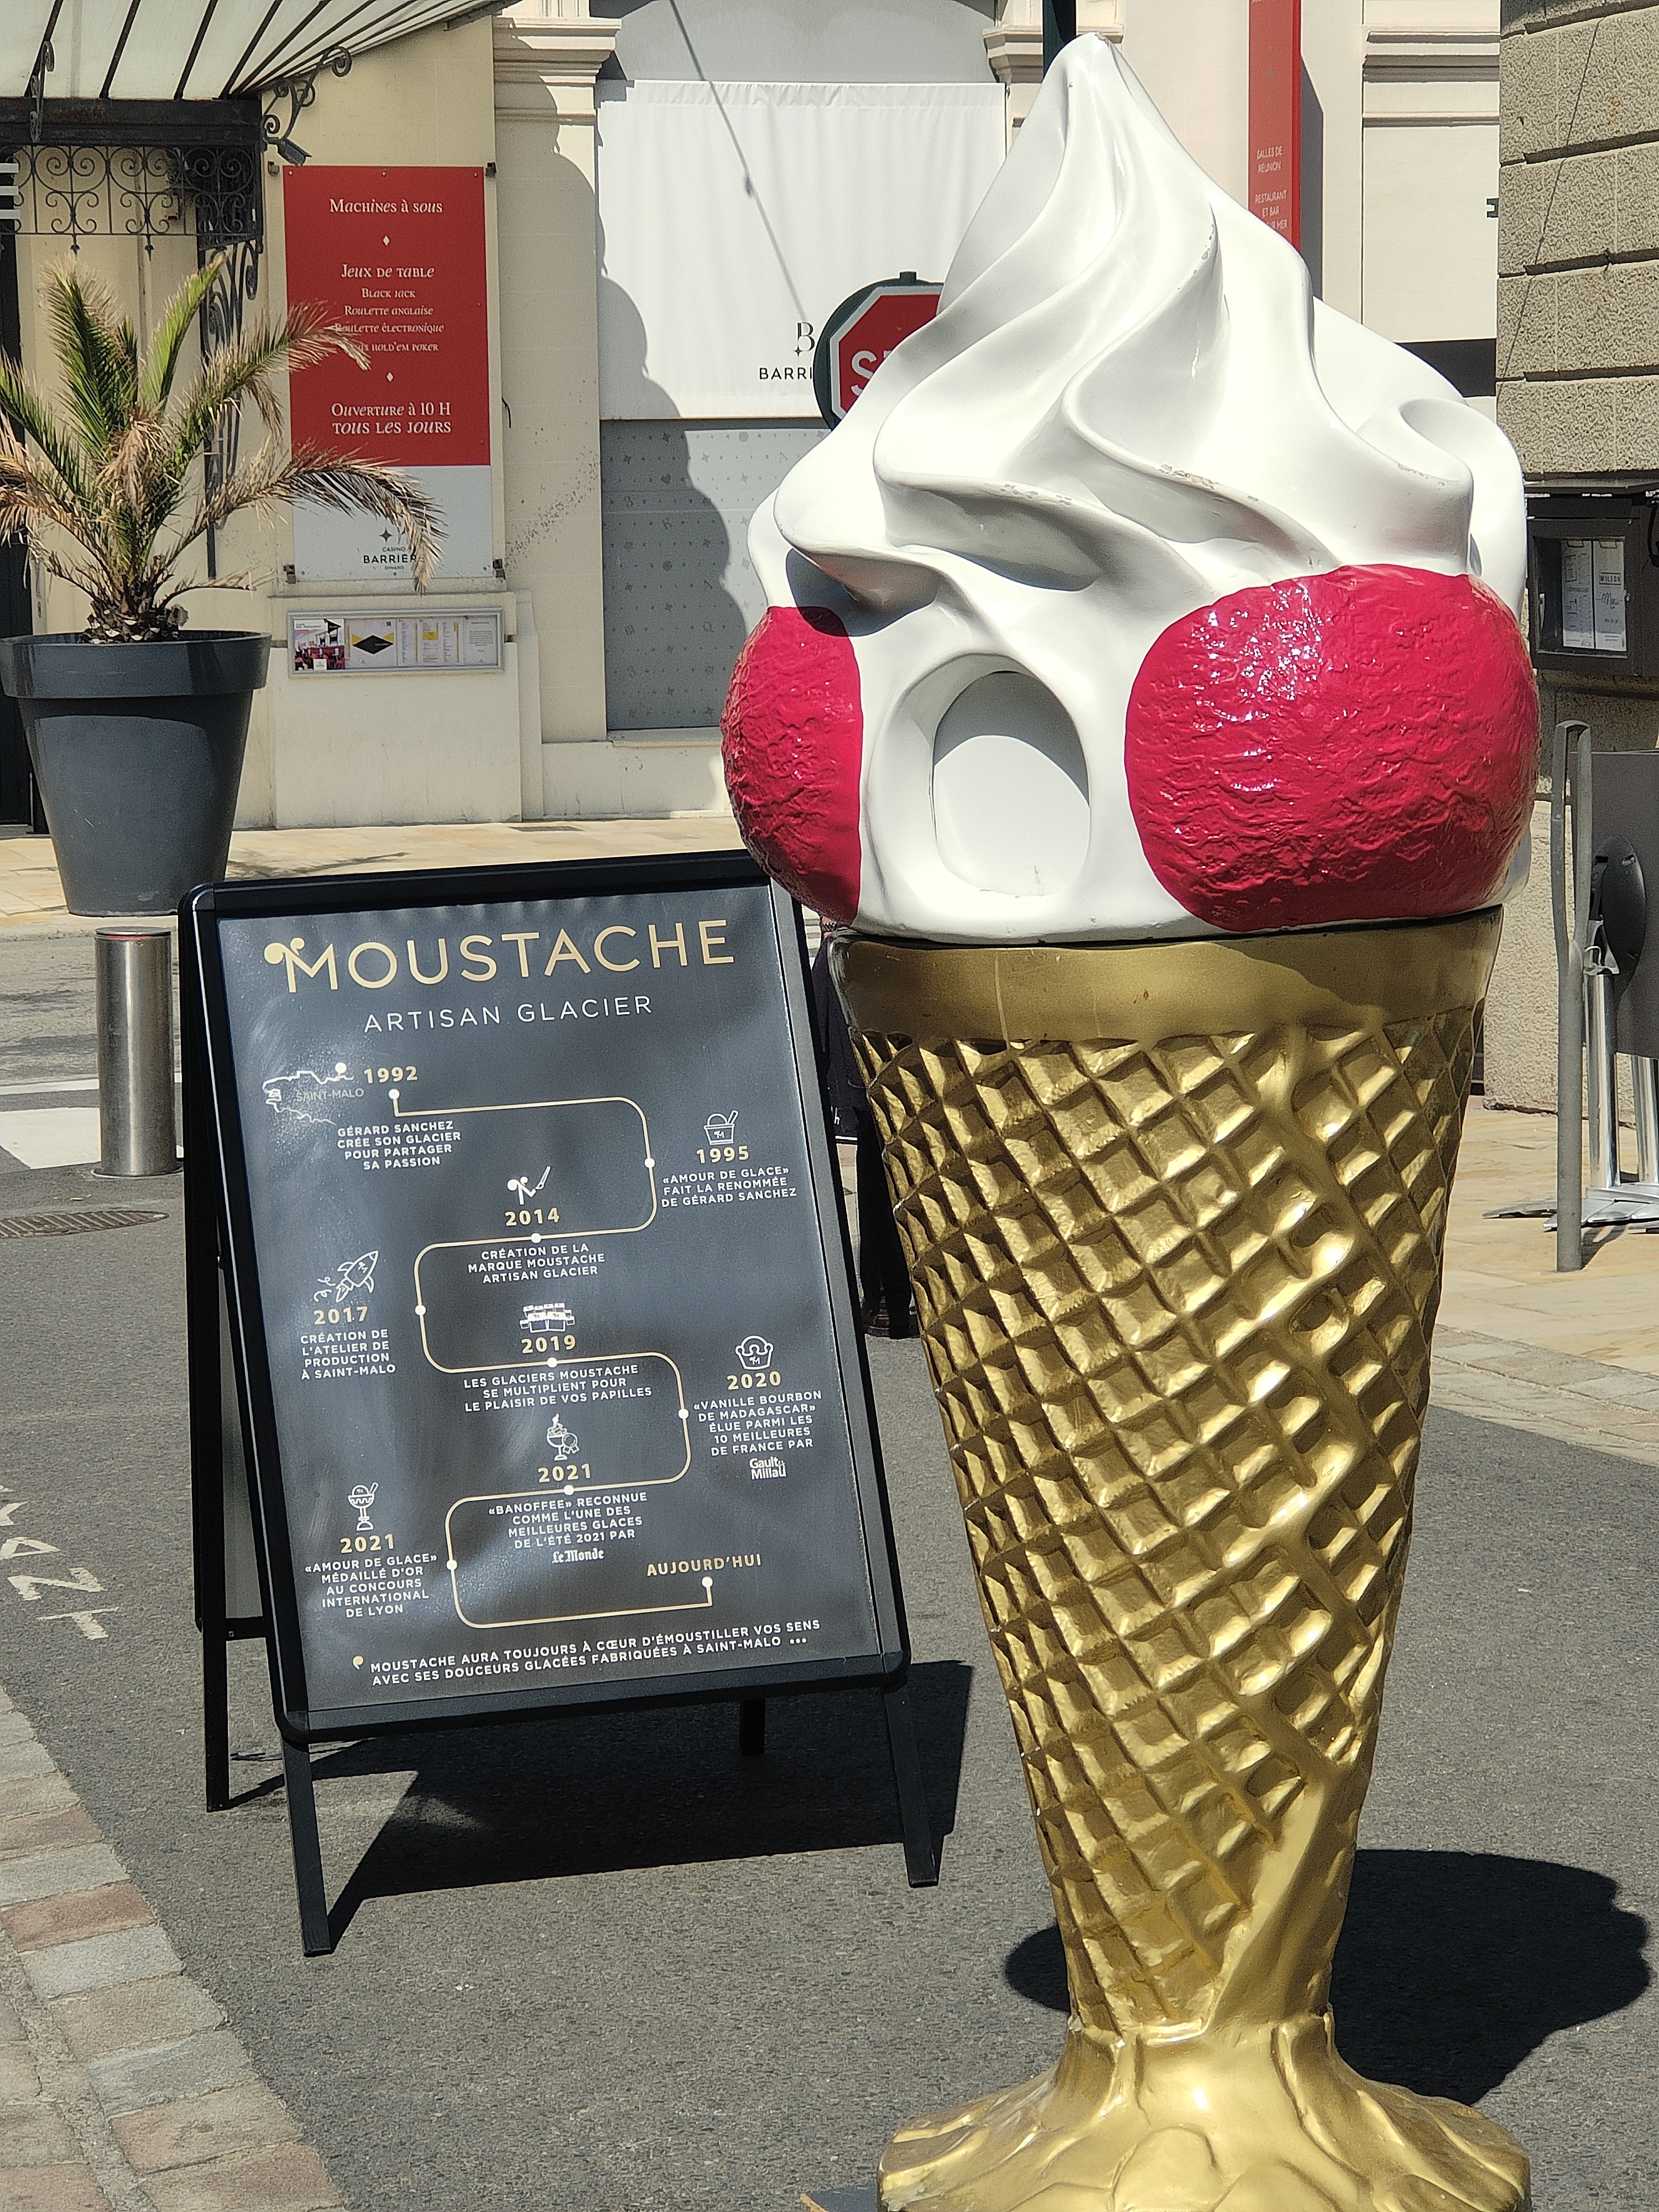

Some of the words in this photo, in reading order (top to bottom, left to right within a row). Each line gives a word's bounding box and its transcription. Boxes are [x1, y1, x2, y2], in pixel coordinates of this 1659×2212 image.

[330, 199, 397, 213] Machines
[401, 199, 409, 213] à
[413, 203, 442, 213] sous
[341, 264, 372, 278] Jeux
[362, 288, 392, 298] Black
[345, 305, 389, 316] Roulette
[391, 305, 434, 315] anglaise
[331, 403, 404, 416] Ouverture
[408, 402, 416, 416] à
[421, 402, 434, 415] 10
[439, 402, 450, 415] H
[264, 920, 734, 993] MOUSTACHE
[364, 1006, 500, 1033] ARTISAN
[518, 995, 651, 1022] GLACIER
[364, 1066, 418, 1083] 1992
[337, 1125, 389, 1137] GÉRARD
[394, 1120, 453, 1133] SANCHEZ
[337, 1136, 370, 1149] CRÉE
[374, 1136, 401, 1146] SON
[406, 1131, 461, 1144] GLACIER
[345, 1149, 379, 1160] POUR
[384, 1144, 452, 1157] PARTAGER
[696, 1145, 749, 1164] 1995
[363, 1160, 380, 1170] SA
[384, 1156, 440, 1168] PASSION
[662, 1172, 715, 1184] «AMOUR
[719, 1170, 736, 1180] DE
[741, 1166, 789, 1177] GLACE»
[664, 1185, 692, 1196] FAIT
[697, 1183, 713, 1193] LA
[717, 1176, 787, 1191] RENOMMÉE
[661, 1198, 678, 1207] DE
[682, 1193, 733, 1206] GÉRARD
[738, 1187, 797, 1201] SANCHEZ
[505, 1208, 560, 1226] 2014
[481, 1246, 546, 1260] CRÉATION
[551, 1245, 568, 1255] DE
[572, 1243, 589, 1253] LA
[468, 1260, 522, 1273] MARQUE
[526, 1253, 605, 1268] MOUSTACHE
[483, 1270, 538, 1284] ARTISAN
[543, 1266, 598, 1278] GLACIER
[314, 1306, 368, 1325] 2017
[300, 1331, 366, 1344] CRÉATION
[371, 1329, 388, 1339] DE
[521, 1334, 576, 1354] 2019
[302, 1343, 368, 1356] L'ATELIER
[372, 1340, 389, 1350] DE
[305, 1352, 389, 1368] PRODUCTION
[301, 1369, 310, 1380] À
[315, 1364, 396, 1379] SAINT-MALO
[464, 1378, 487, 1389] LES
[492, 1372, 555, 1386] GLACIERS
[560, 1364, 638, 1380] MOUSTACHE
[727, 1371, 781, 1390] 2020
[483, 1389, 499, 1399] SE
[503, 1381, 586, 1397] MULTIPLIENT
[592, 1378, 626, 1389] POUR
[465, 1402, 480, 1412] LE
[485, 1397, 535, 1410] PLAISIR
[540, 1395, 556, 1405] DE
[561, 1392, 587, 1403] VOS
[592, 1387, 652, 1401] PAPILLES
[693, 1396, 755, 1410] «VANILLE
[759, 1390, 821, 1405] BOURBON
[698, 1412, 715, 1422] DE
[719, 1404, 816, 1420] MADAGASCAR»
[709, 1421, 741, 1433] ÉLUE
[745, 1417, 785, 1430] PARMI
[790, 1415, 812, 1425] LES
[714, 1434, 728, 1444] 10
[733, 1427, 811, 1442] MEILLEURES
[711, 1446, 728, 1456] DE
[732, 1441, 784, 1454] FRANCE
[788, 1438, 813, 1449] PAR
[538, 1463, 591, 1483] 2021
[751, 1467, 786, 1480] Millau
[488, 1499, 572, 1515] «BANOFFEE»
[577, 1492, 648, 1507] RECONNUE
[513, 1511, 559, 1525] COMME
[564, 1508, 602, 1520] L'UNE
[606, 1505, 631, 1516] DES
[508, 1521, 587, 1538] MEILLEURES
[592, 1516, 643, 1530] GLACES
[340, 1533, 394, 1553] 2021
[514, 1538, 531, 1549] DE
[536, 1533, 571, 1547] L'ÉTÉ
[576, 1531, 604, 1543] 2021
[609, 1529, 635, 1540] PAR
[305, 1560, 359, 1573] «AMOUR
[364, 1557, 382, 1568] DE
[387, 1553, 437, 1566] GLACE»
[647, 1553, 761, 1577] AUJOURD'HUI
[321, 1567, 387, 1584] MÉDAILLÉ
[392, 1566, 423, 1578] D'OR
[326, 1585, 344, 1595] AU
[349, 1578, 421, 1593] CONCOURS
[322, 1589, 429, 1608] INTERNATIONAL
[346, 1608, 363, 1618] DE
[368, 1604, 403, 1616] LYON
[371, 1656, 456, 1673] MOUSTACHE
[461, 1651, 499, 1665] AURA
[503, 1644, 577, 1660] TOUJOURS
[582, 1641, 591, 1652] À
[596, 1638, 637, 1651] CŒUR
[642, 1627, 749, 1647] D'ÉMOUSTILLER
[753, 1624, 781, 1635] VOS
[786, 1620, 820, 1632] SENS
[372, 1673, 409, 1686] AVEC
[415, 1670, 439, 1681] SES
[445, 1662, 519, 1678] DOUCEURS
[524, 1655, 586, 1671] GLACÉES
[592, 1646, 677, 1664] FABRIQUÉES
[683, 1643, 692, 1655] À
[697, 1636, 781, 1653] SAINT-MALO
